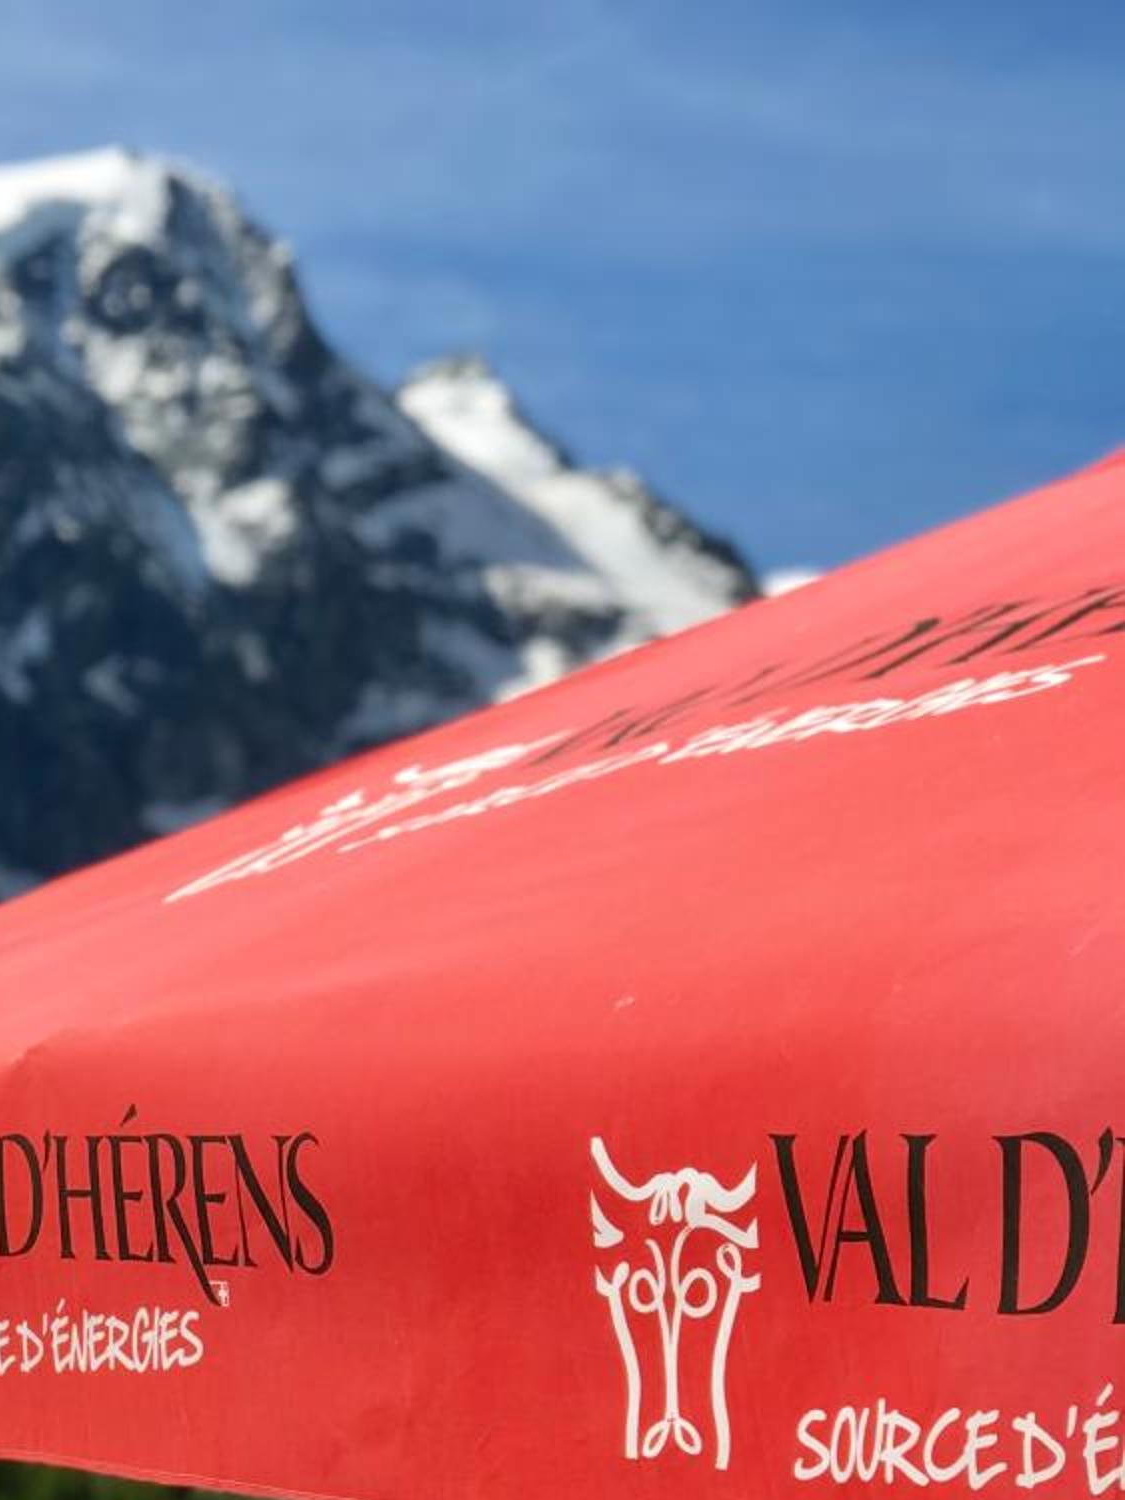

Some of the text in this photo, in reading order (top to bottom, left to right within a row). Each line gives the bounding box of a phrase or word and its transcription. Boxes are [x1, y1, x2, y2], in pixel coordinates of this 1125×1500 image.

[768, 1126, 1125, 1326] VAL D'
[15, 1298, 204, 1373] D'ÉNERGIES
[793, 1383, 1125, 1496] SOURCE D'É
